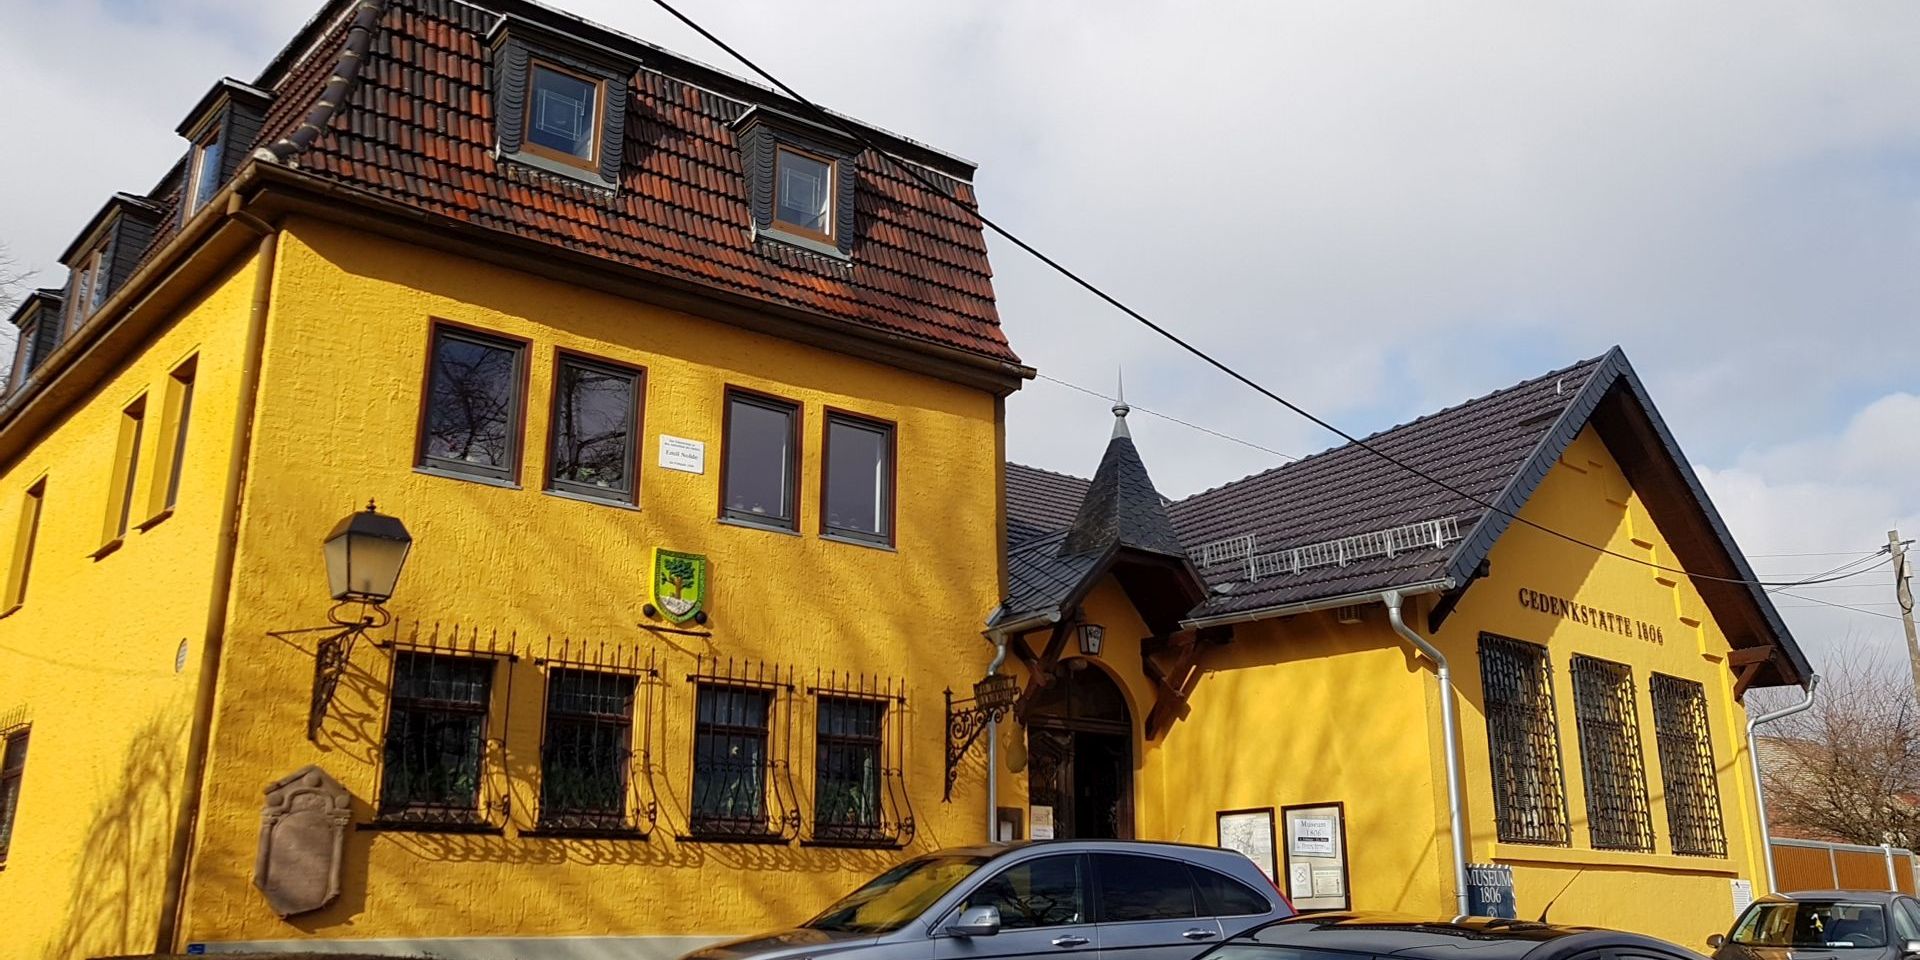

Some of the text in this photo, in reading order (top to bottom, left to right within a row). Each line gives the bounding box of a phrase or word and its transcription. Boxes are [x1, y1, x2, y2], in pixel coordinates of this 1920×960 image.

[1636, 620, 1664, 647] 1806
[1301, 820, 1327, 828] Museum
[1465, 869, 1511, 887] MUSEUM
[1480, 886, 1502, 904] 1806
